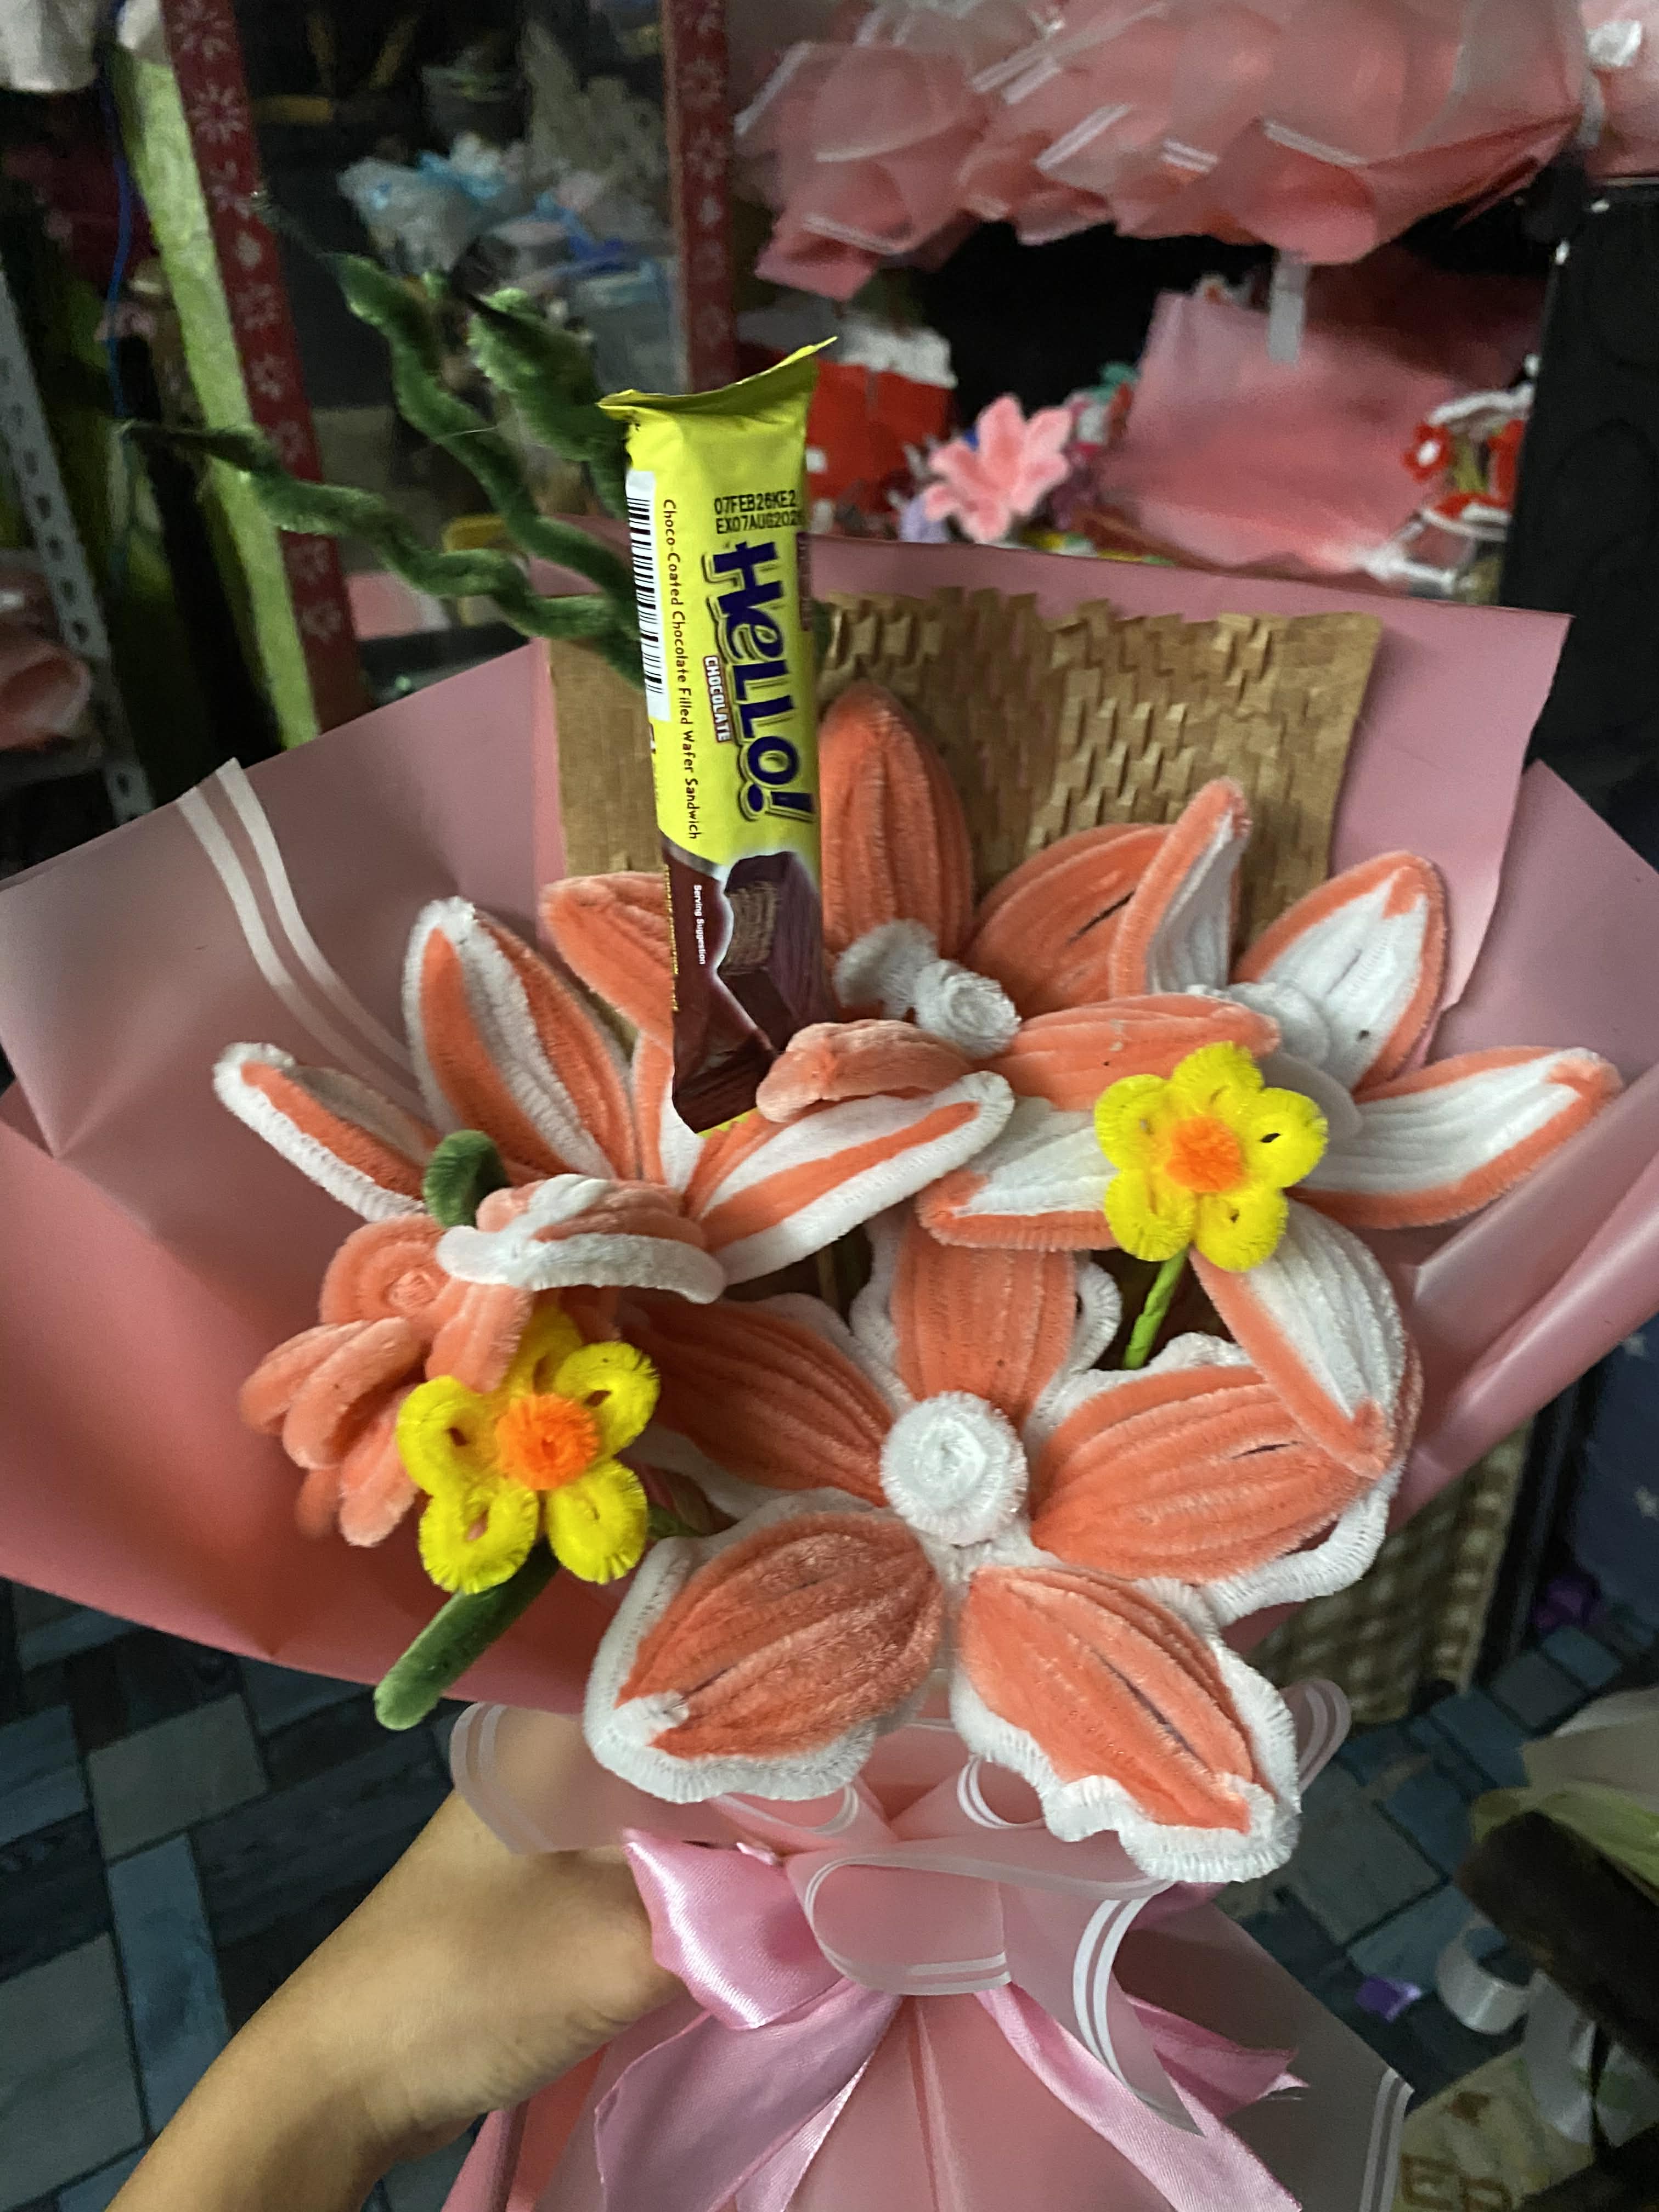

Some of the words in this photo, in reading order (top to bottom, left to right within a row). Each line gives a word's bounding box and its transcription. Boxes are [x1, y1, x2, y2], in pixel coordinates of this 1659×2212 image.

[663, 499, 684, 606] Choco-Coated
[672, 611, 690, 682] Chocolate
[678, 687, 693, 725] Filled
[704, 656, 731, 741] CHOCOLATE
[681, 730, 696, 772] Wafer
[685, 778, 702, 839] Sandwich
[693, 884, 703, 917] Serving
[696, 918, 706, 964] Suggestion
